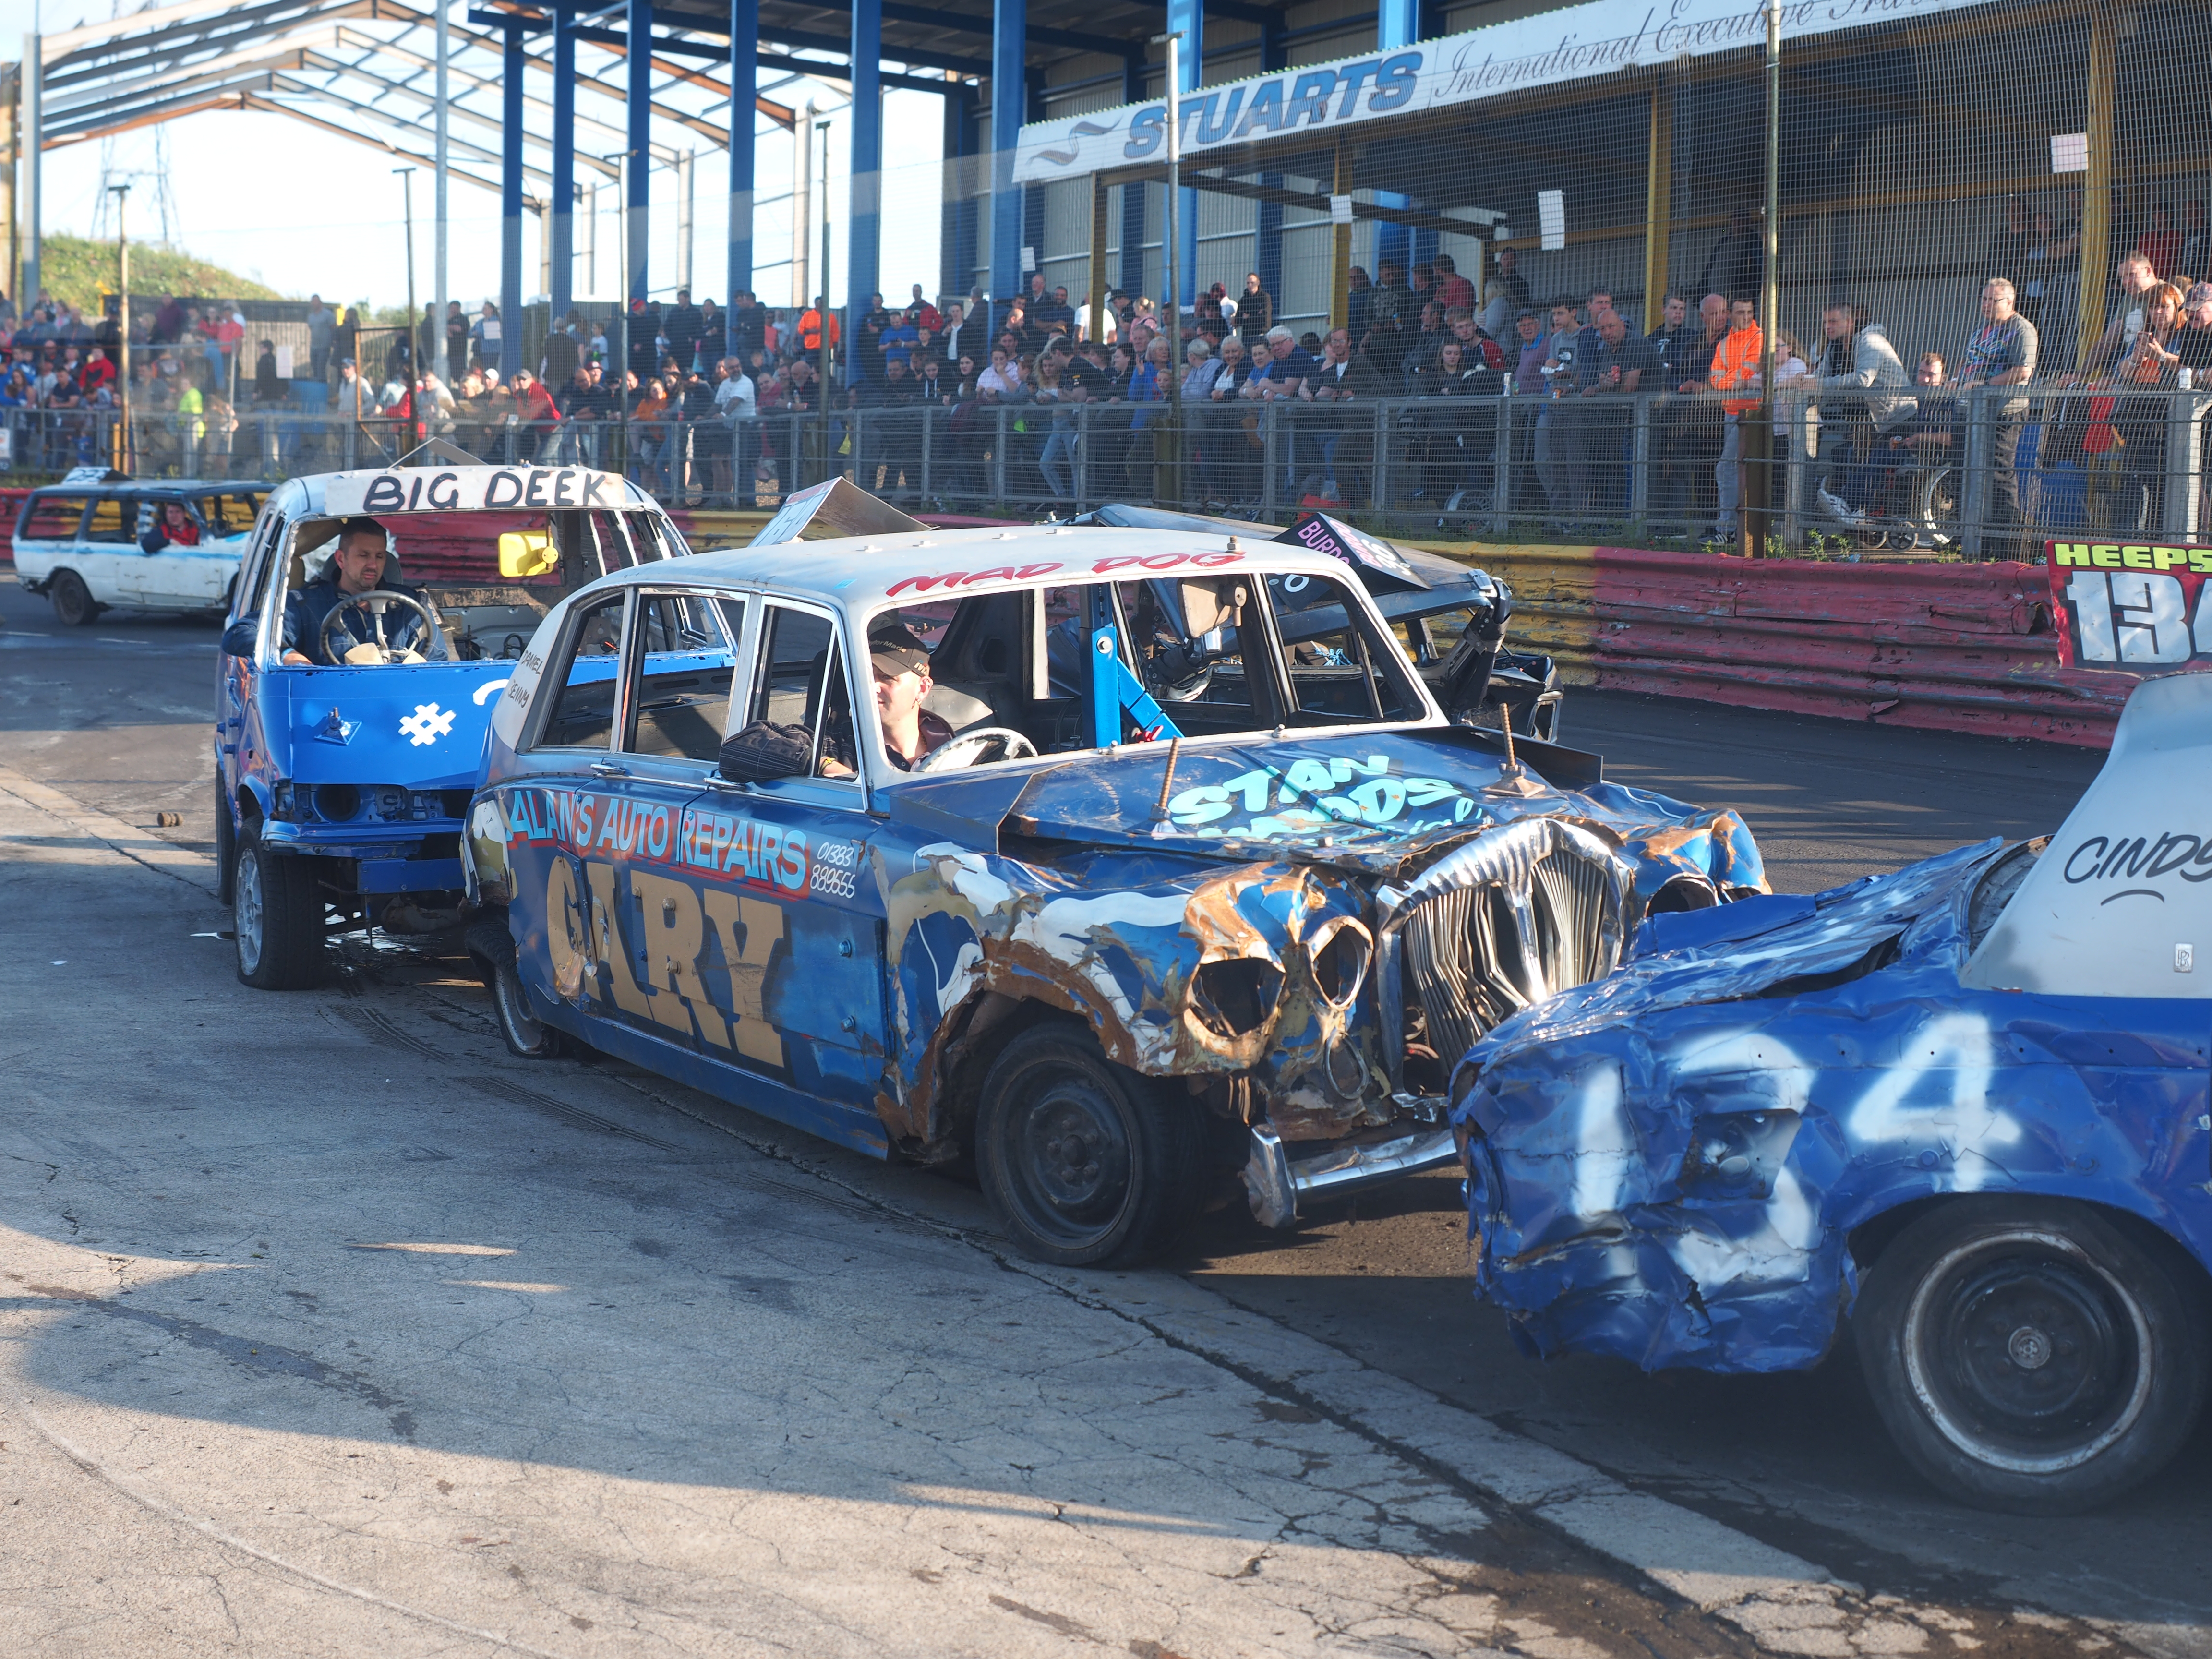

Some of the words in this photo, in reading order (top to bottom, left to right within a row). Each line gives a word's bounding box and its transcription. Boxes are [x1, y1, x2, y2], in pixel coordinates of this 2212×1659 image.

[1435, 7, 1655, 98] International
[1123, 51, 1423, 159] STUARTS
[363, 472, 459, 513] BIG
[484, 470, 609, 508] DEEK
[885, 562, 1064, 597] MAD
[1091, 552, 1247, 574] DOG
[1168, 755, 1390, 824] STAN
[596, 798, 669, 857] AUTO
[676, 809, 807, 890] REPAIRS
[817, 842, 854, 867] 01383
[546, 854, 785, 1068] GARY
